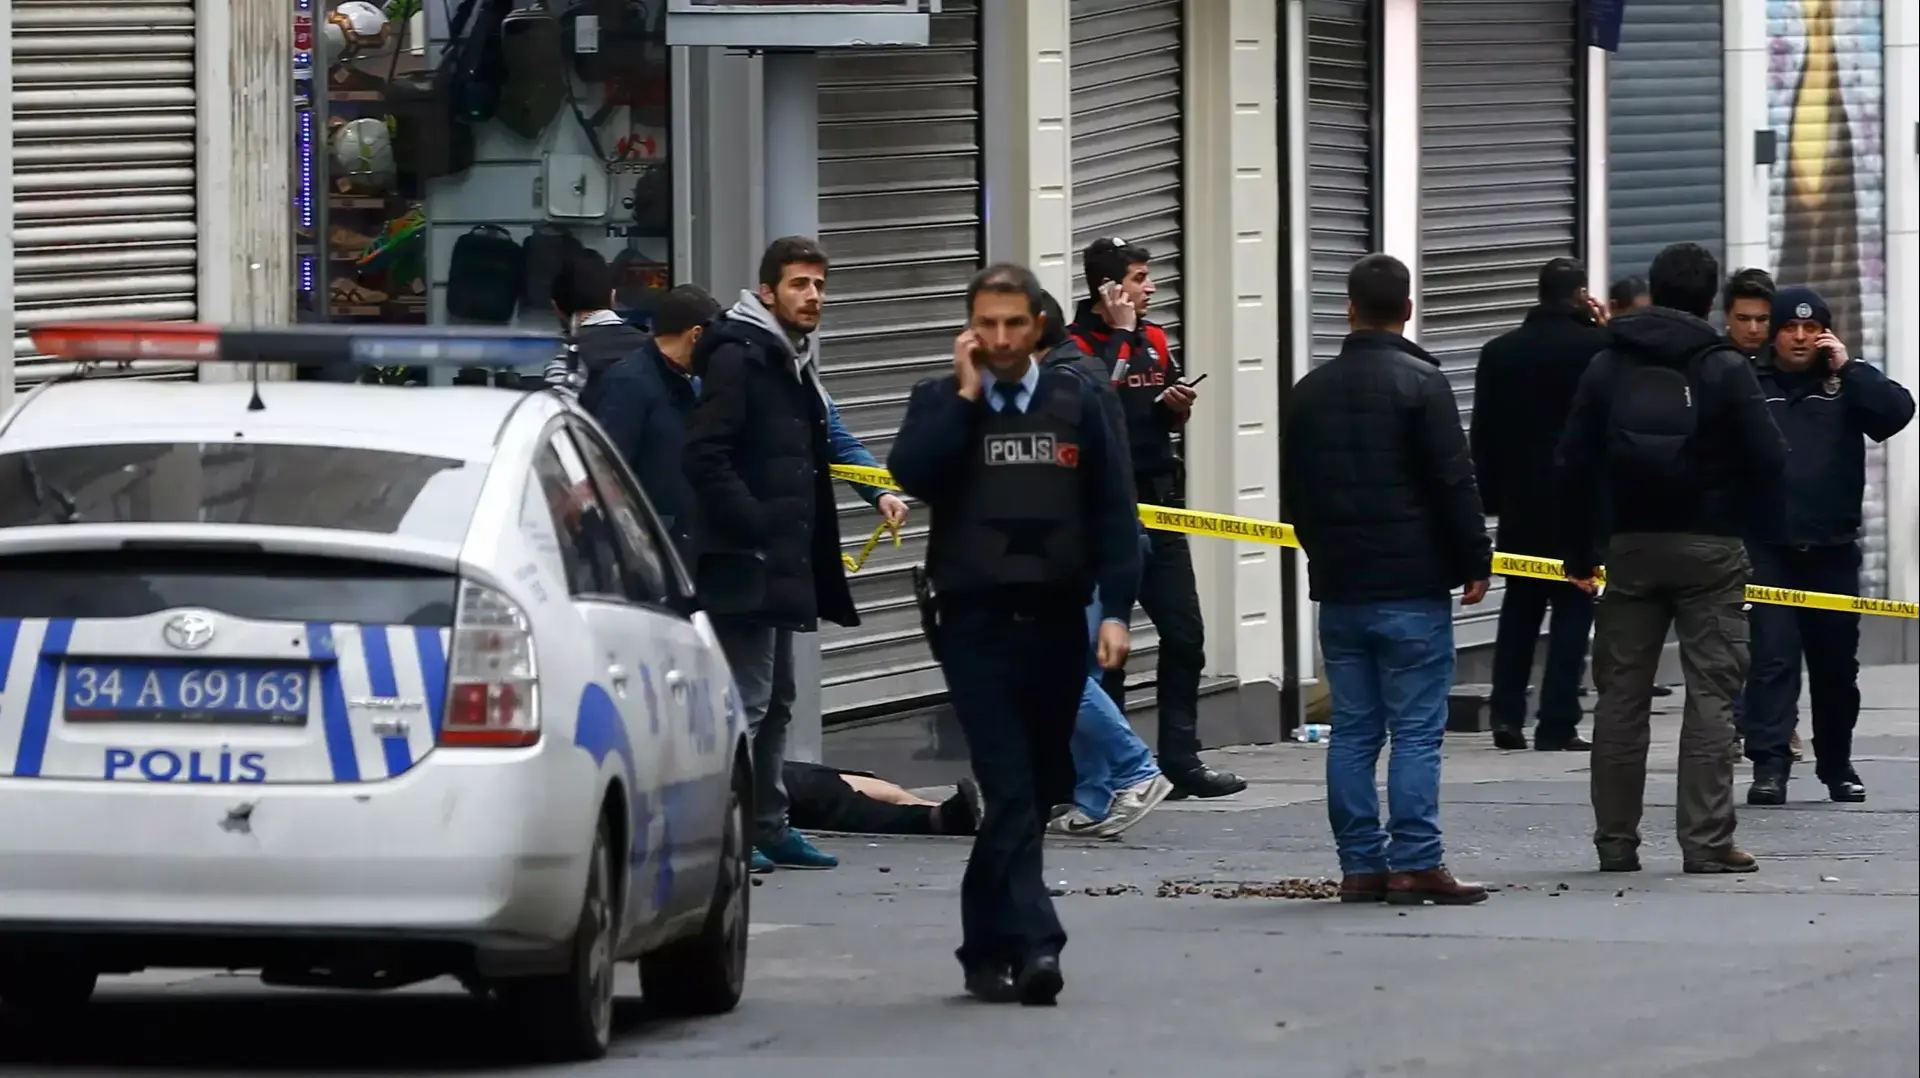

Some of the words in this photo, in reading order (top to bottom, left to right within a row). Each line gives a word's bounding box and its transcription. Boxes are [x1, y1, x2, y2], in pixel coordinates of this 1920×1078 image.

[1252, 524, 1284, 540] OLAY
[74, 667, 123, 707] 34
[135, 669, 166, 707] A
[179, 669, 304, 712] 69163
